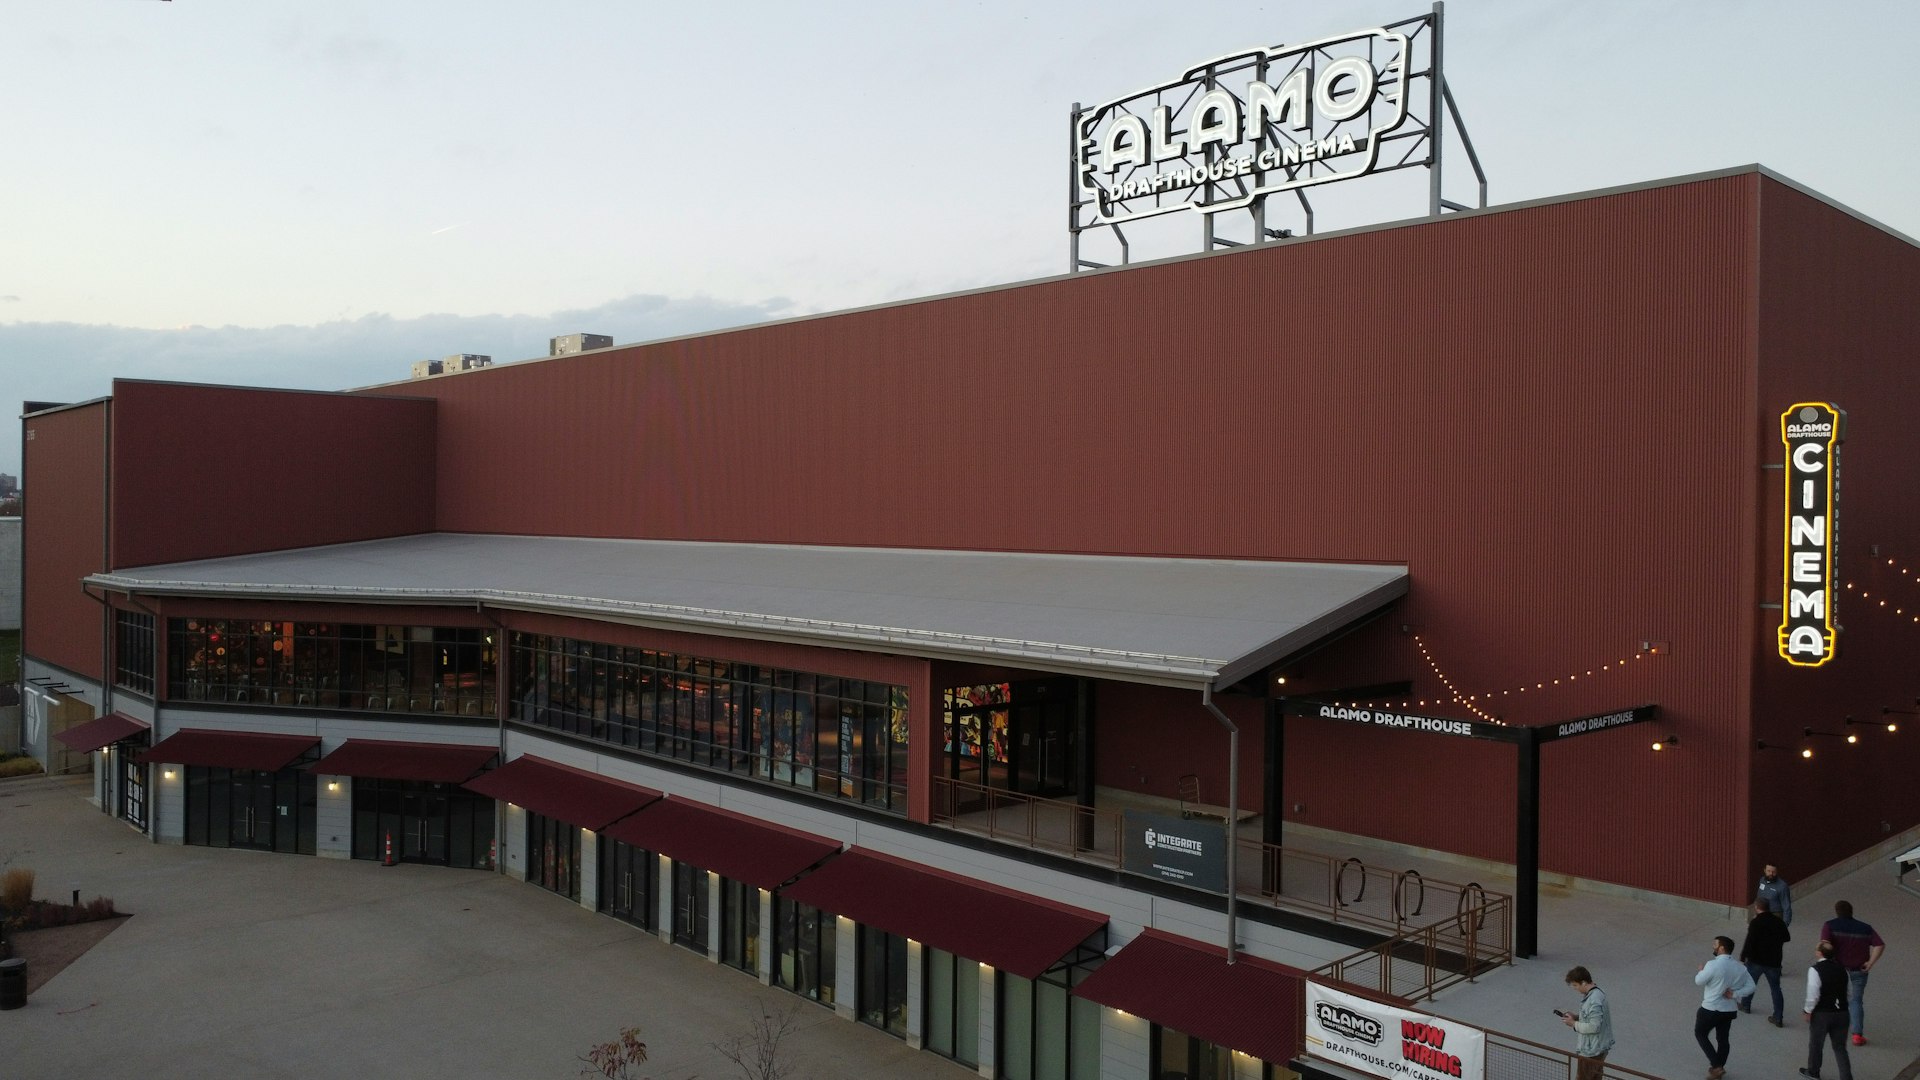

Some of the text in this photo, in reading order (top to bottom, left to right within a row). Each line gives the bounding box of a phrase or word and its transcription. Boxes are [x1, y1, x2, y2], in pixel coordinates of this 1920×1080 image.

[1103, 56, 1377, 175] ALAMO
[1109, 133, 1357, 203] DRAFTHOUSE CINEMA
[1787, 423, 1832, 433] ALAMO
[1789, 443, 1825, 656] CINEMA
[1320, 705, 1472, 736] ALAMO DRAFTHOUSE
[1558, 711, 1634, 737] ALAMO DRAFTHOUSE
[1158, 833, 1201, 851] INTEGRATE
[1321, 1006, 1377, 1035] ALAMO
[1323, 1019, 1375, 1042] DRAFTHOUSE CINEMA
[1401, 1019, 1446, 1050] NOW
[1326, 1041, 1440, 1080] DRAFTHOUSE.COM/CAR
[1402, 1039, 1462, 1078] HIRING
